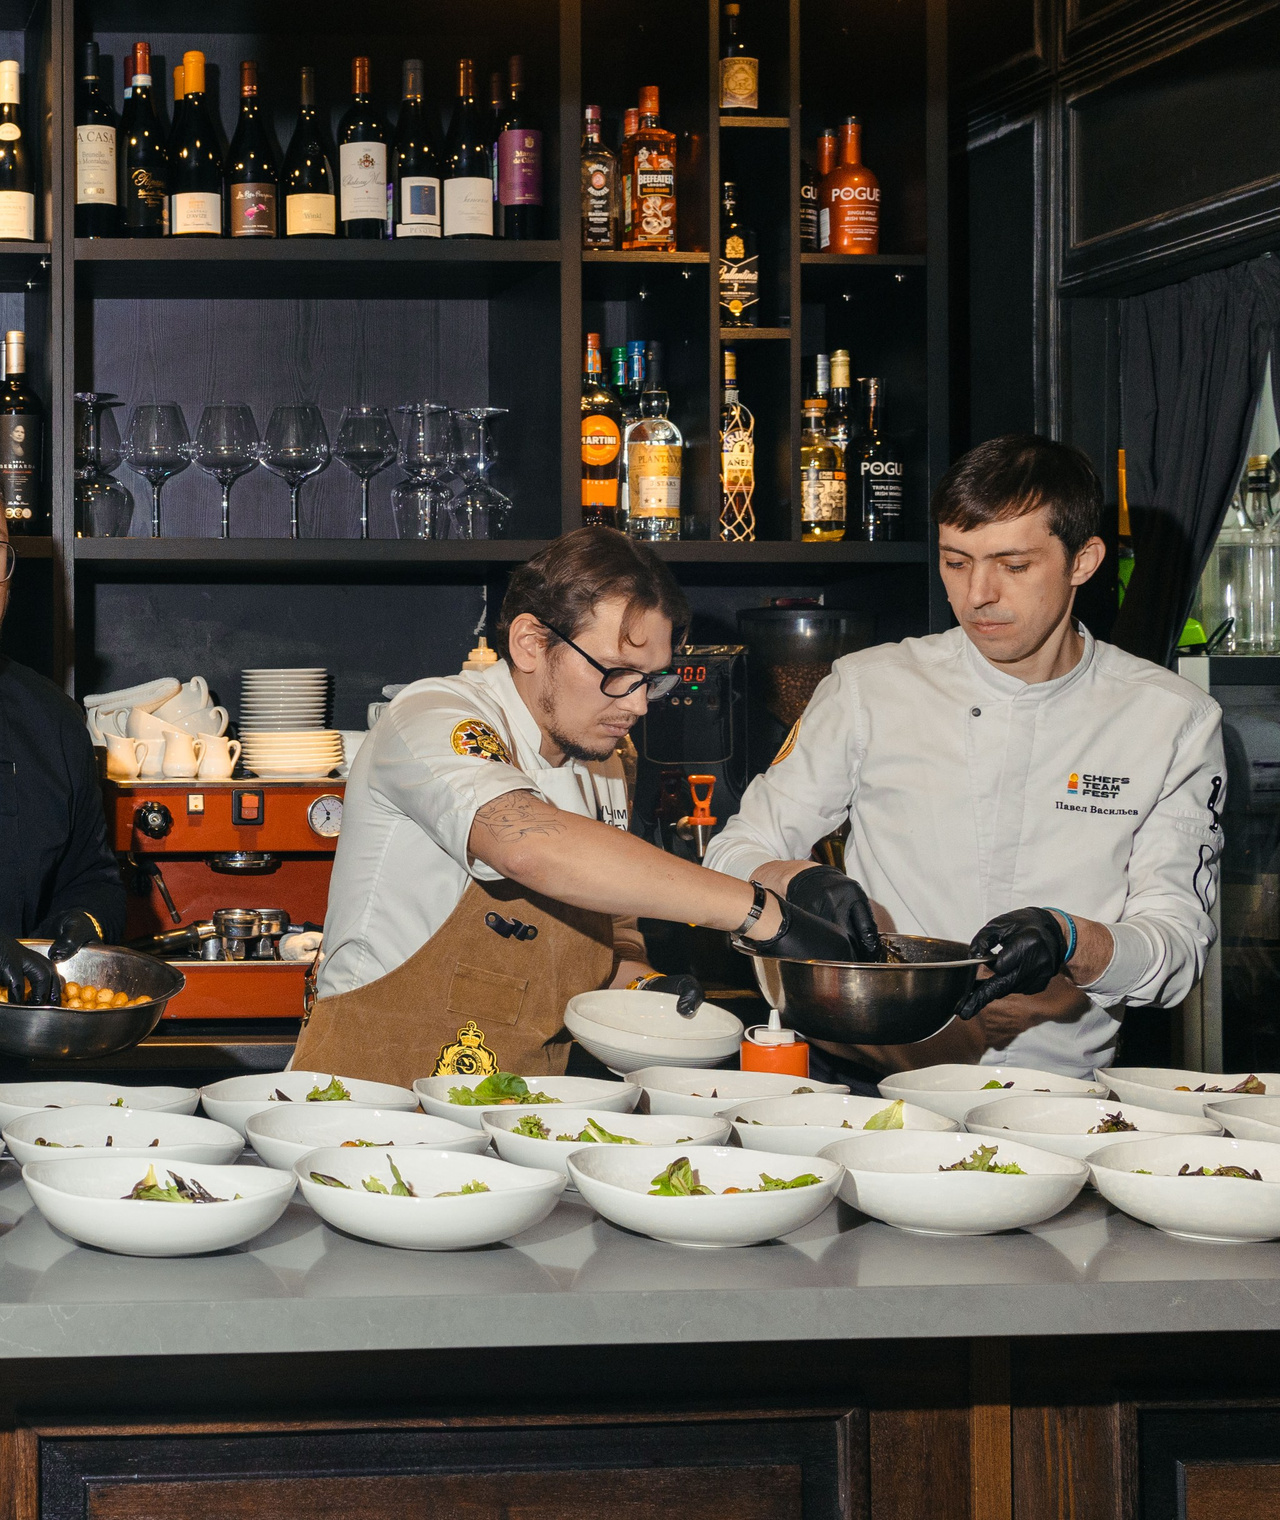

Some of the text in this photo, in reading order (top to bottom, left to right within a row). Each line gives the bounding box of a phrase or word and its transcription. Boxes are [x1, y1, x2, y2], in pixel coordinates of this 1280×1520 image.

[86, 130, 115, 144] CASA
[638, 174, 674, 185] BEEFEATER
[861, 461, 902, 476] POGU
[1082, 773, 1130, 784] CHEFS
[1082, 781, 1121, 791] TEAM
[1082, 788, 1119, 799] FEST
[1056, 801, 1139, 816] Павел Васильев
